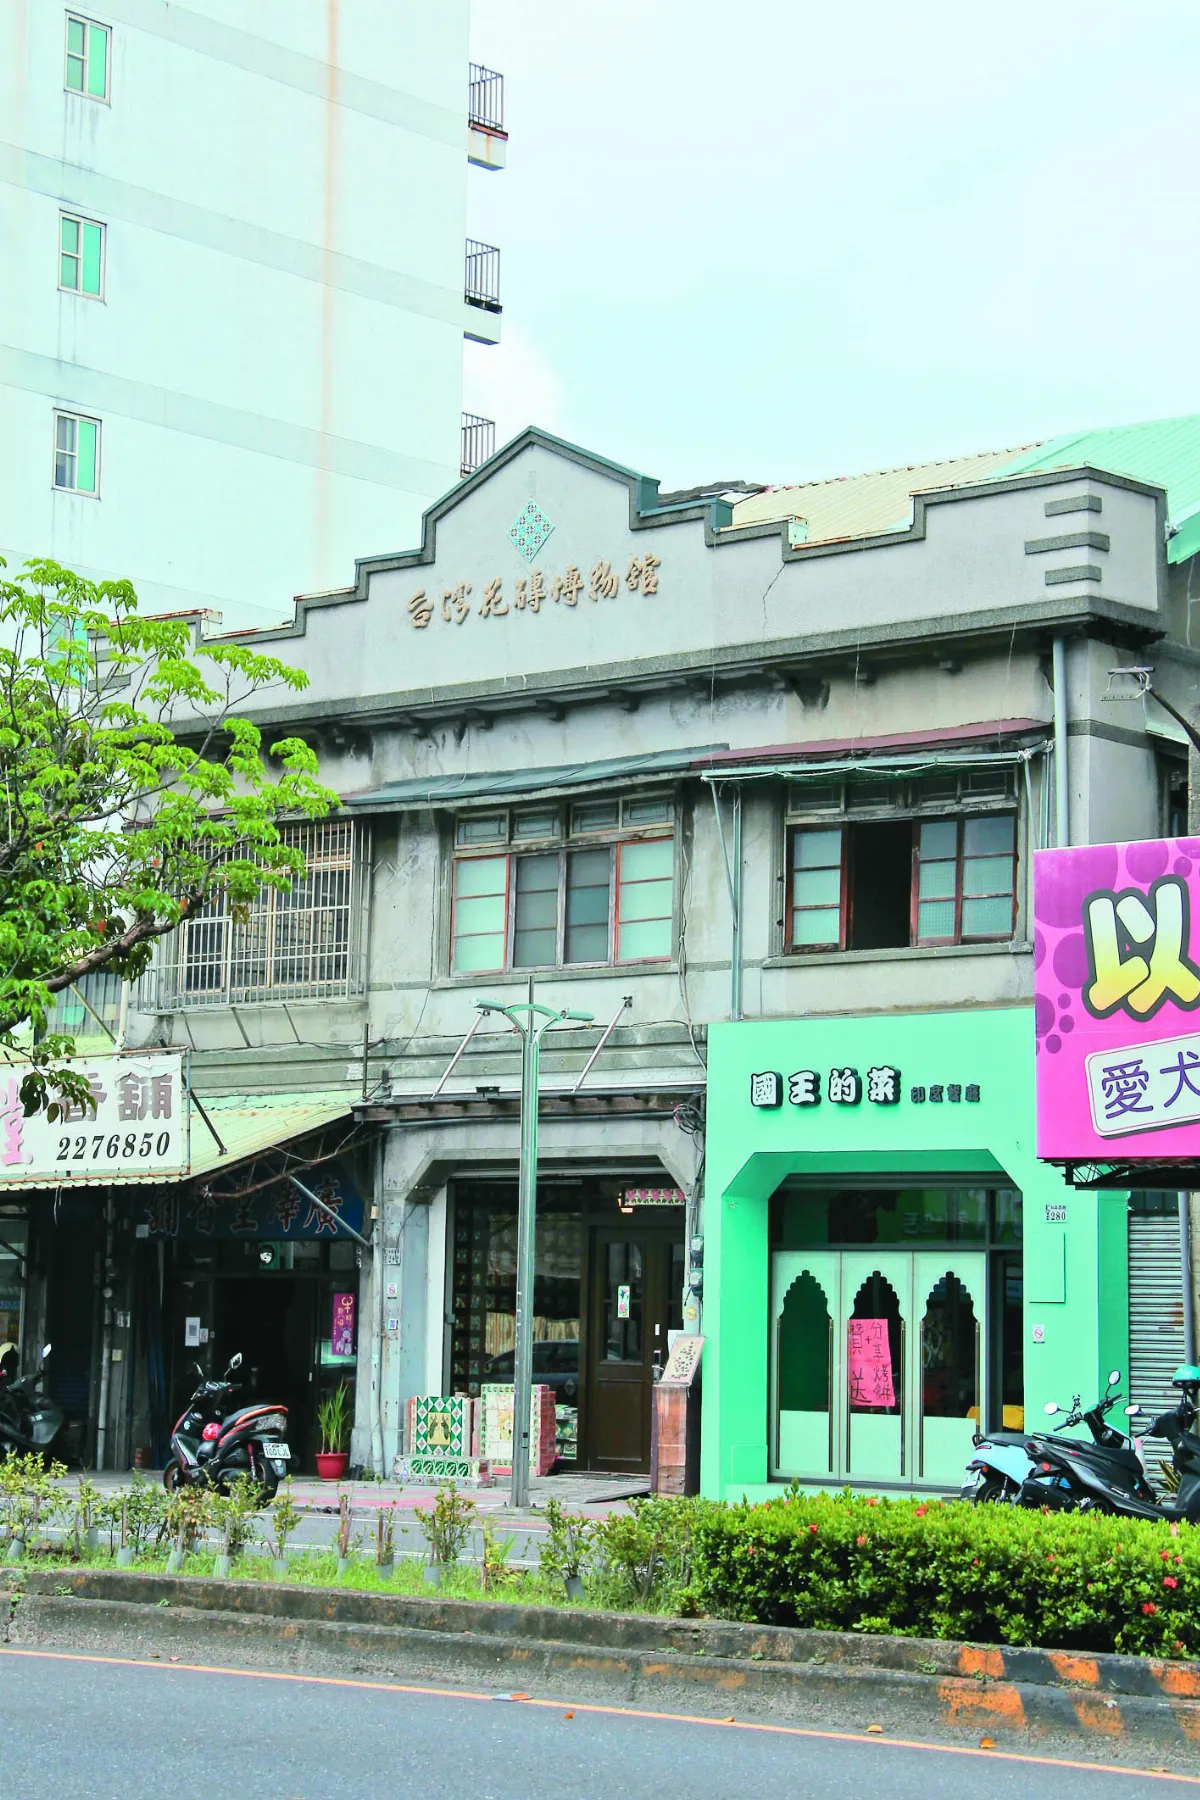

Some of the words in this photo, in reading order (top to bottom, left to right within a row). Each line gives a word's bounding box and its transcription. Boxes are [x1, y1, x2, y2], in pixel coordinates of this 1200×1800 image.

[407, 551, 662, 629] 台灣花磚博物館
[751, 1065, 901, 1108] 國王的菜
[911, 1084, 980, 1103] 印度餐廳
[56, 1131, 170, 1161] 2276850
[1050, 1211, 1066, 1221] 280
